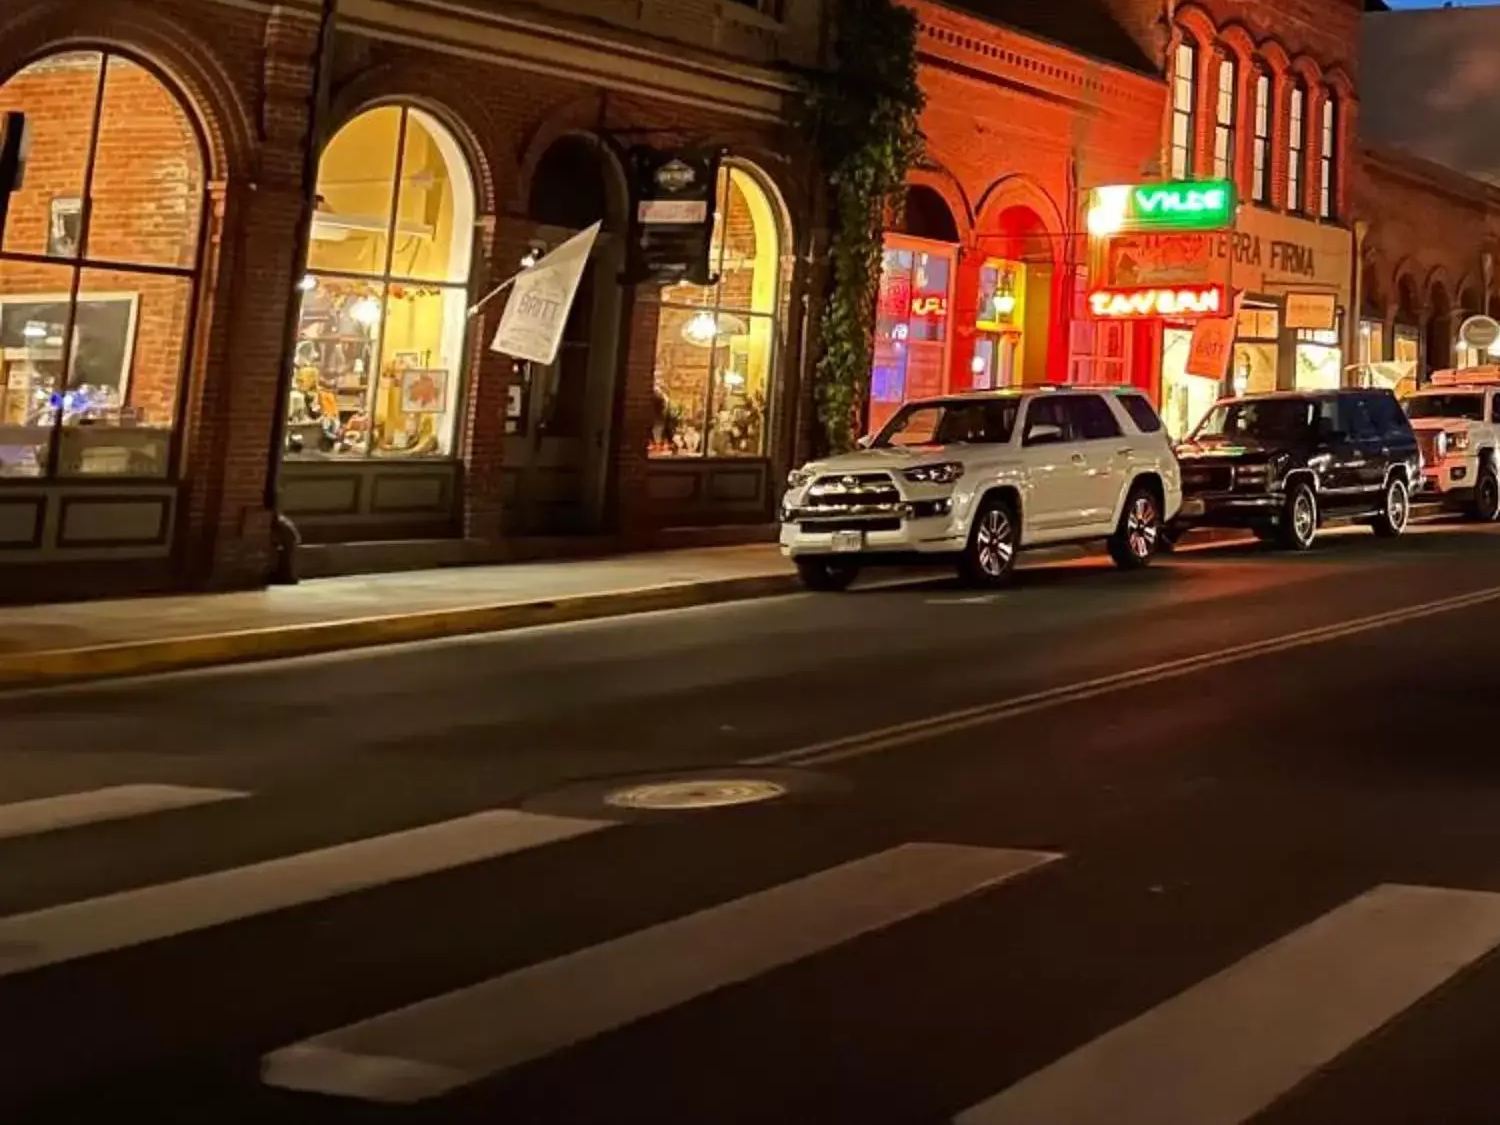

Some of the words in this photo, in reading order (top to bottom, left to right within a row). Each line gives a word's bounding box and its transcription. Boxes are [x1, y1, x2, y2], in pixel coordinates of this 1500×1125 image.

[1268, 240, 1315, 279] FIRMA
[517, 293, 562, 321] BRITT
[1089, 288, 1220, 316] TAVERN
